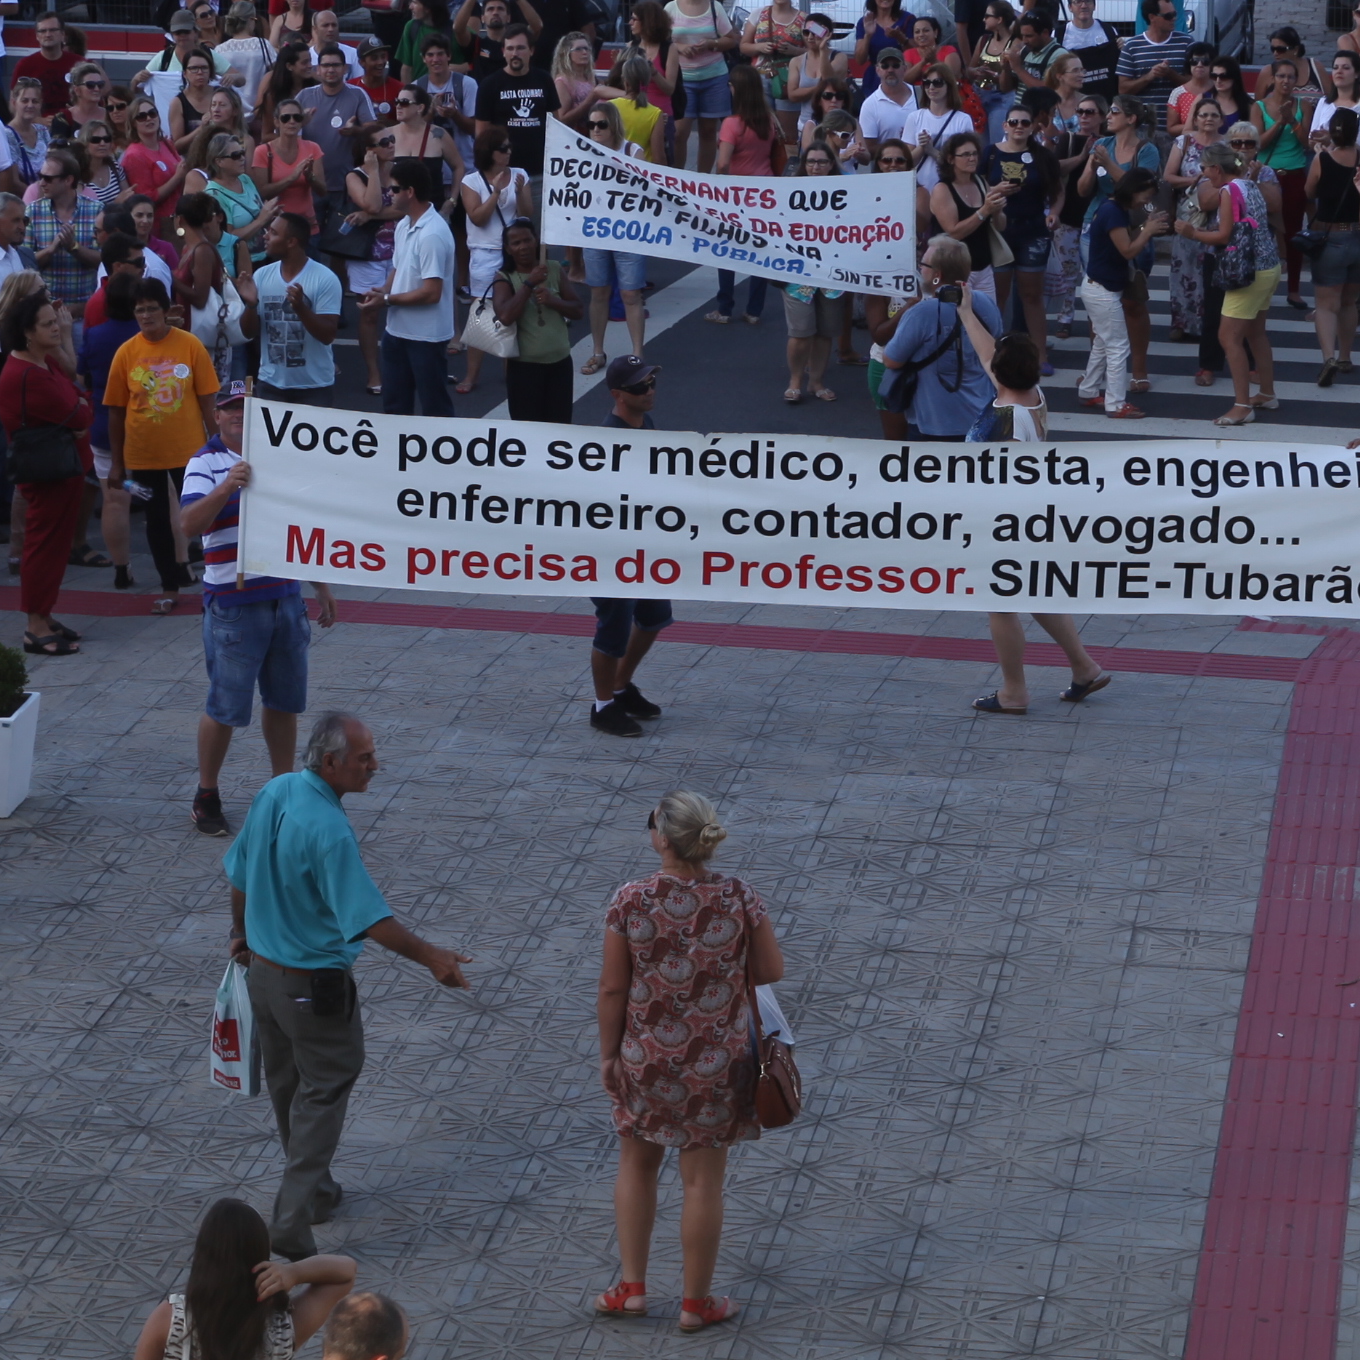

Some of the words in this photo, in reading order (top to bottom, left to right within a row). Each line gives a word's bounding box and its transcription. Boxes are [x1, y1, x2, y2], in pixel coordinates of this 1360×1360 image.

[500, 90, 517, 100] BASTA
[548, 181, 593, 210] NÃO
[606, 190, 653, 218] TEM
[785, 242, 823, 262] NA
[550, 157, 650, 192] DECIDEM
[748, 217, 784, 238] DA
[788, 215, 905, 252] EDUCAÇÃO
[788, 189, 848, 212] QUE
[582, 216, 673, 245] ESCOLA
[691, 236, 812, 277] PÚBLICA.
[832, 267, 916, 293] SINTE-TB
[260, 406, 379, 459] Você
[398, 427, 527, 472] pode
[545, 440, 632, 473] ser
[649, 437, 857, 490] médico,
[879, 445, 1105, 494] dentista,
[396, 483, 700, 541] enfermeiro,
[721, 500, 972, 549] contador,
[992, 505, 1300, 555] advogado...
[286, 524, 386, 572] Mas
[407, 543, 598, 584] precisa
[614, 548, 681, 585] do
[702, 551, 974, 595] Professor.
